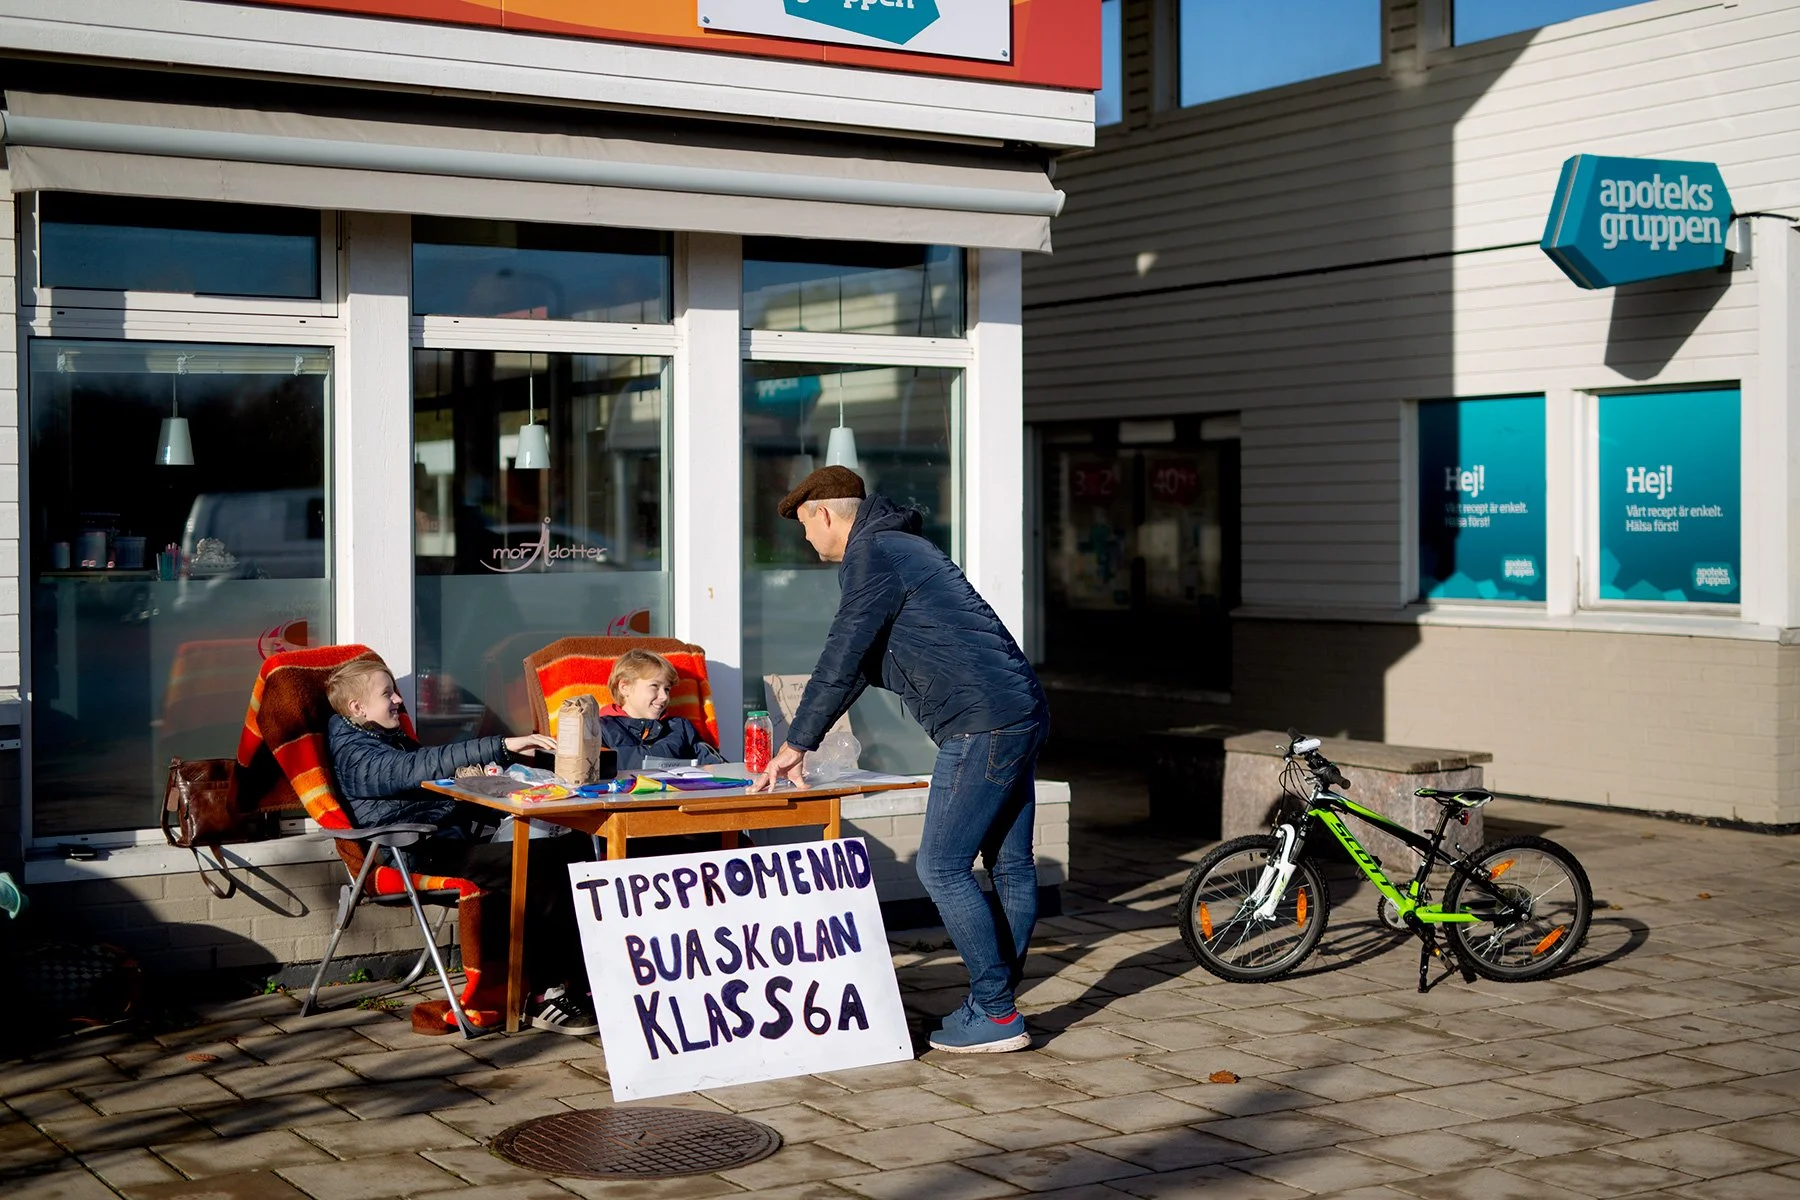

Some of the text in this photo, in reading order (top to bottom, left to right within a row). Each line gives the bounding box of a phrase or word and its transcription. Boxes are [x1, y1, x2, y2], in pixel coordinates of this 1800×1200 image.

[1600, 173, 1713, 212] apoteks
[1600, 213, 1722, 251] gruppen
[1444, 464, 1485, 497] Hej!
[1626, 465, 1673, 500] Hej!
[1463, 502, 1488, 516] recept
[1626, 504, 1723, 519] Vårt recept är enkelt.
[1626, 519, 1679, 532] Hälsa först!
[492, 547, 531, 559] mor
[548, 544, 607, 559] dotter
[1331, 822, 1406, 900] SCOTT
[576, 839, 871, 921] TIPSPROMENAD
